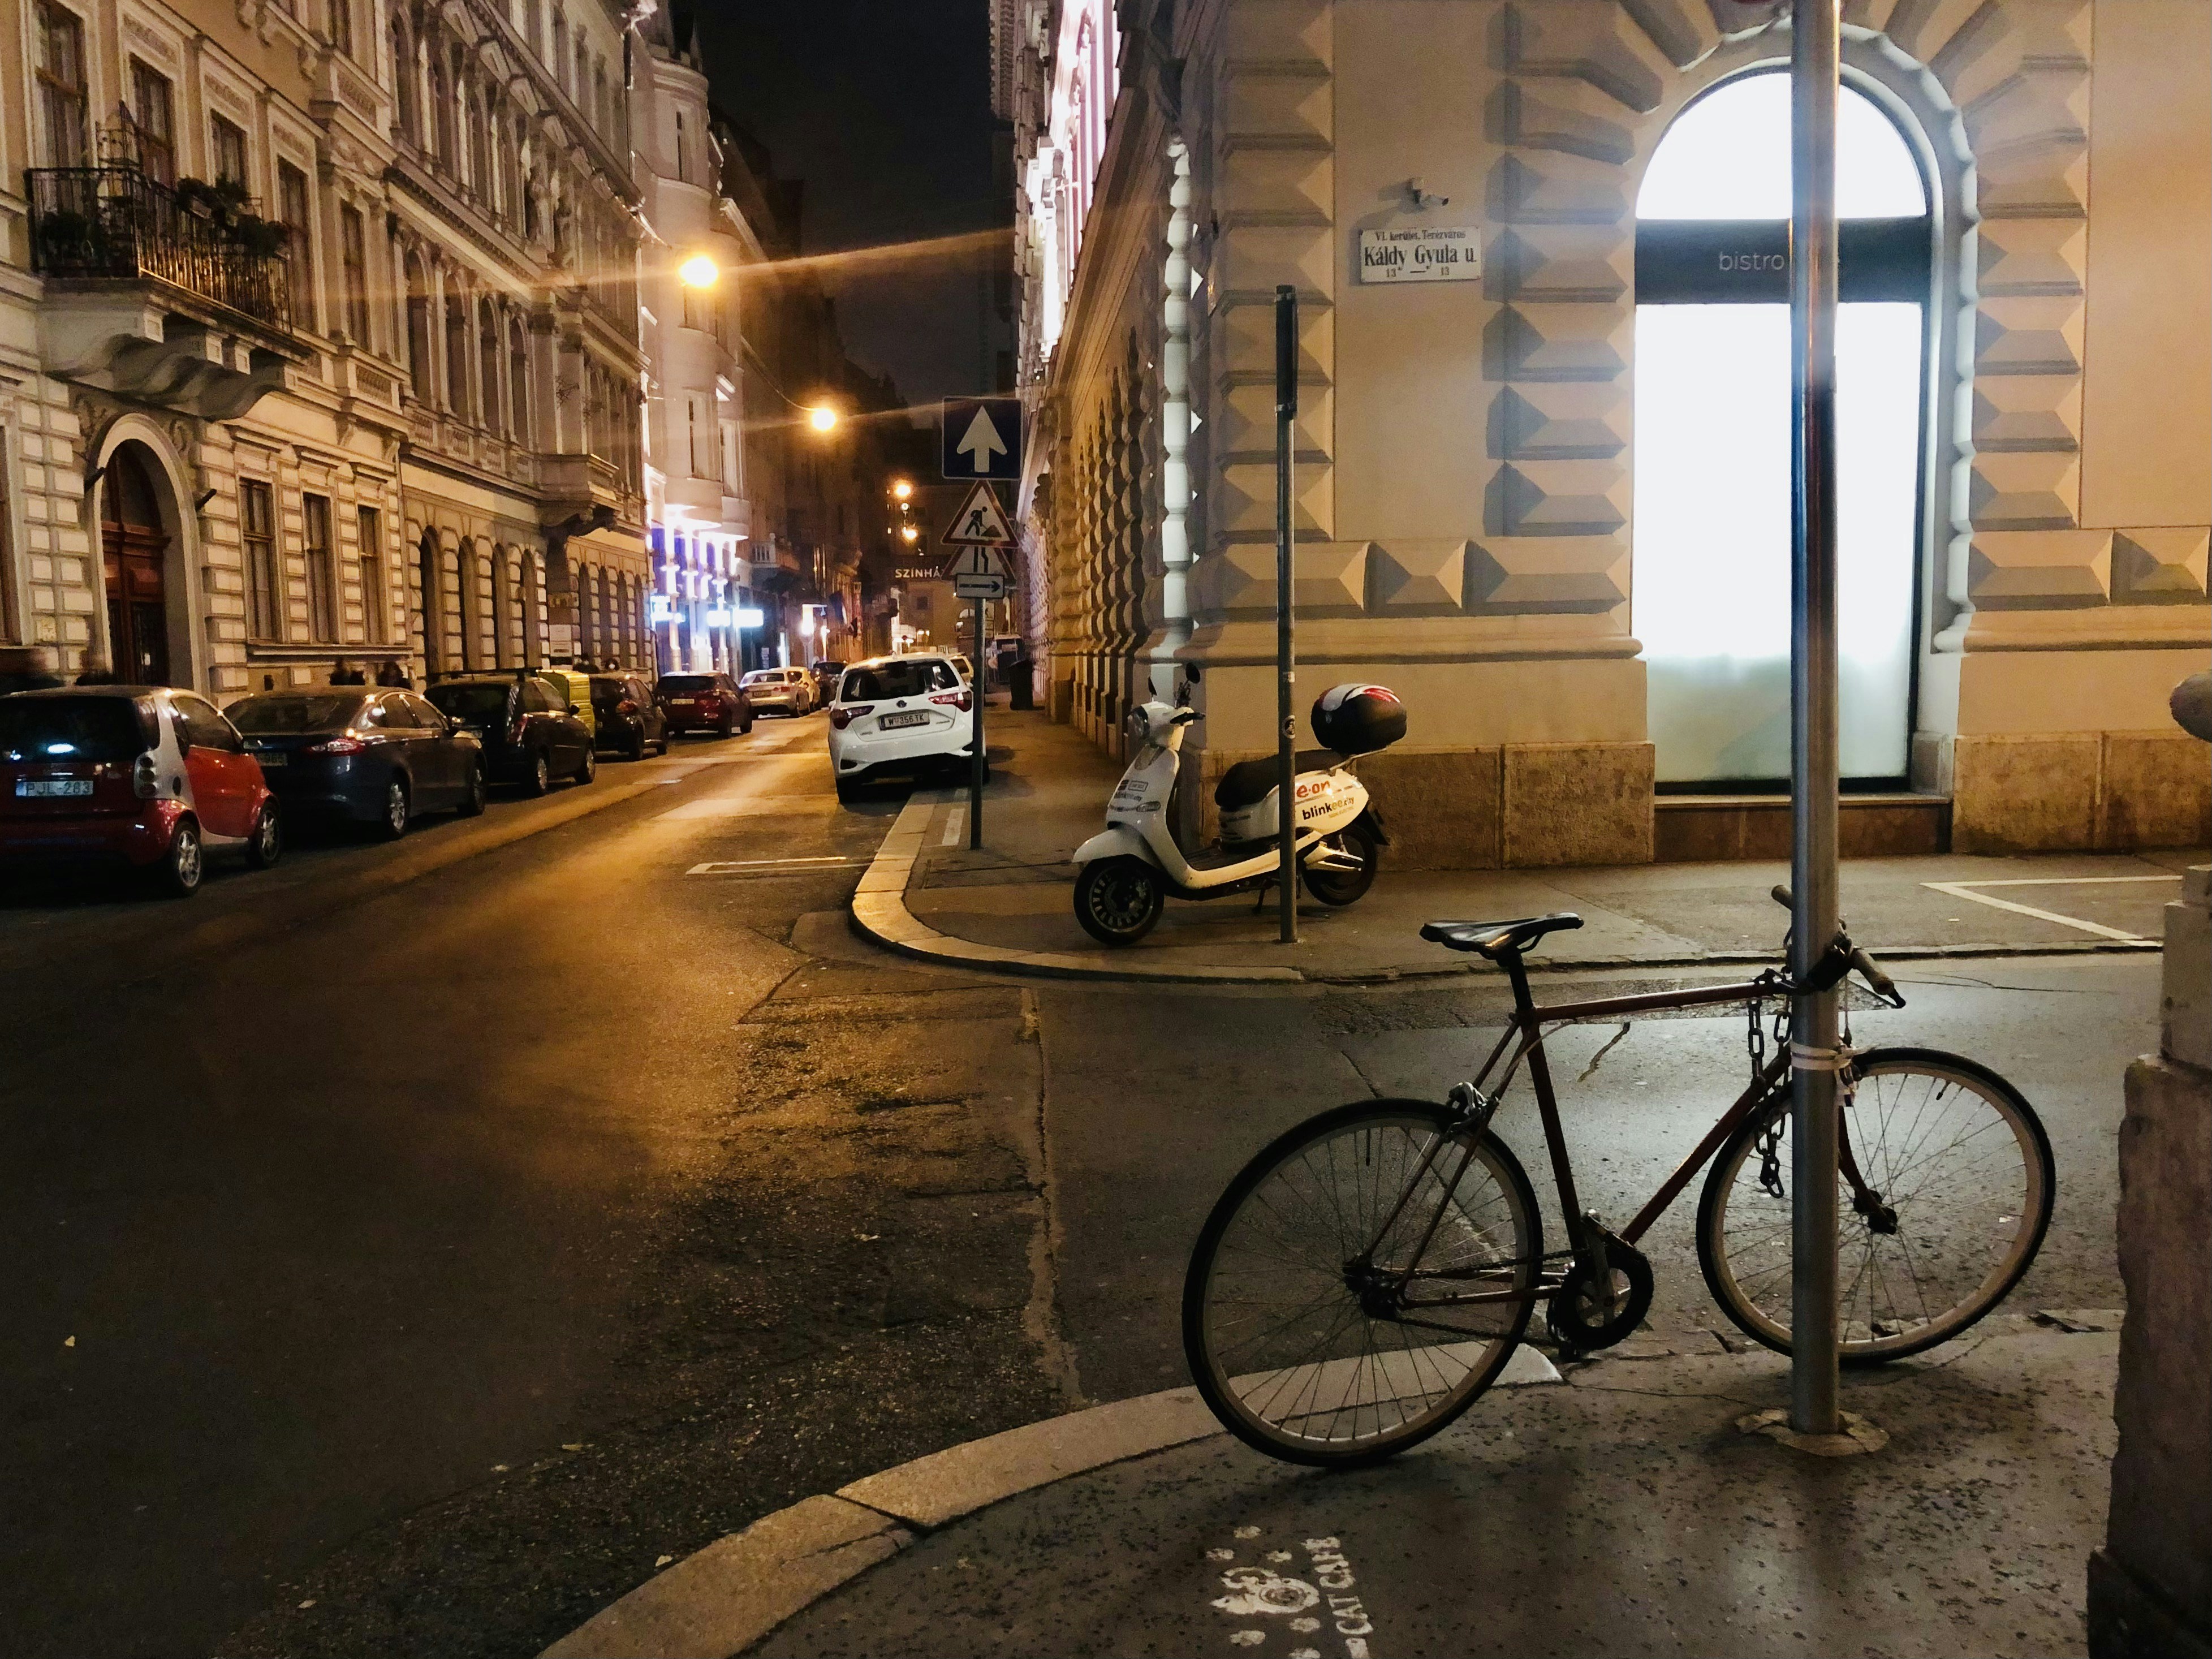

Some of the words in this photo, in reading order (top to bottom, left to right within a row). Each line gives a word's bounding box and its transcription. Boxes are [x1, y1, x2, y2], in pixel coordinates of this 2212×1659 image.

[1365, 245, 1407, 272] Káldy
[1415, 244, 1458, 270] Gyula
[1465, 247, 1477, 263] u.
[1719, 251, 1784, 271] bistro
[1386, 268, 1396, 278] 13
[1441, 266, 1450, 275] 13
[895, 566, 941, 579] SZÍNHÁ
[1302, 796, 1354, 820] blinkee.city
[1326, 1593, 1374, 1635] CAT
